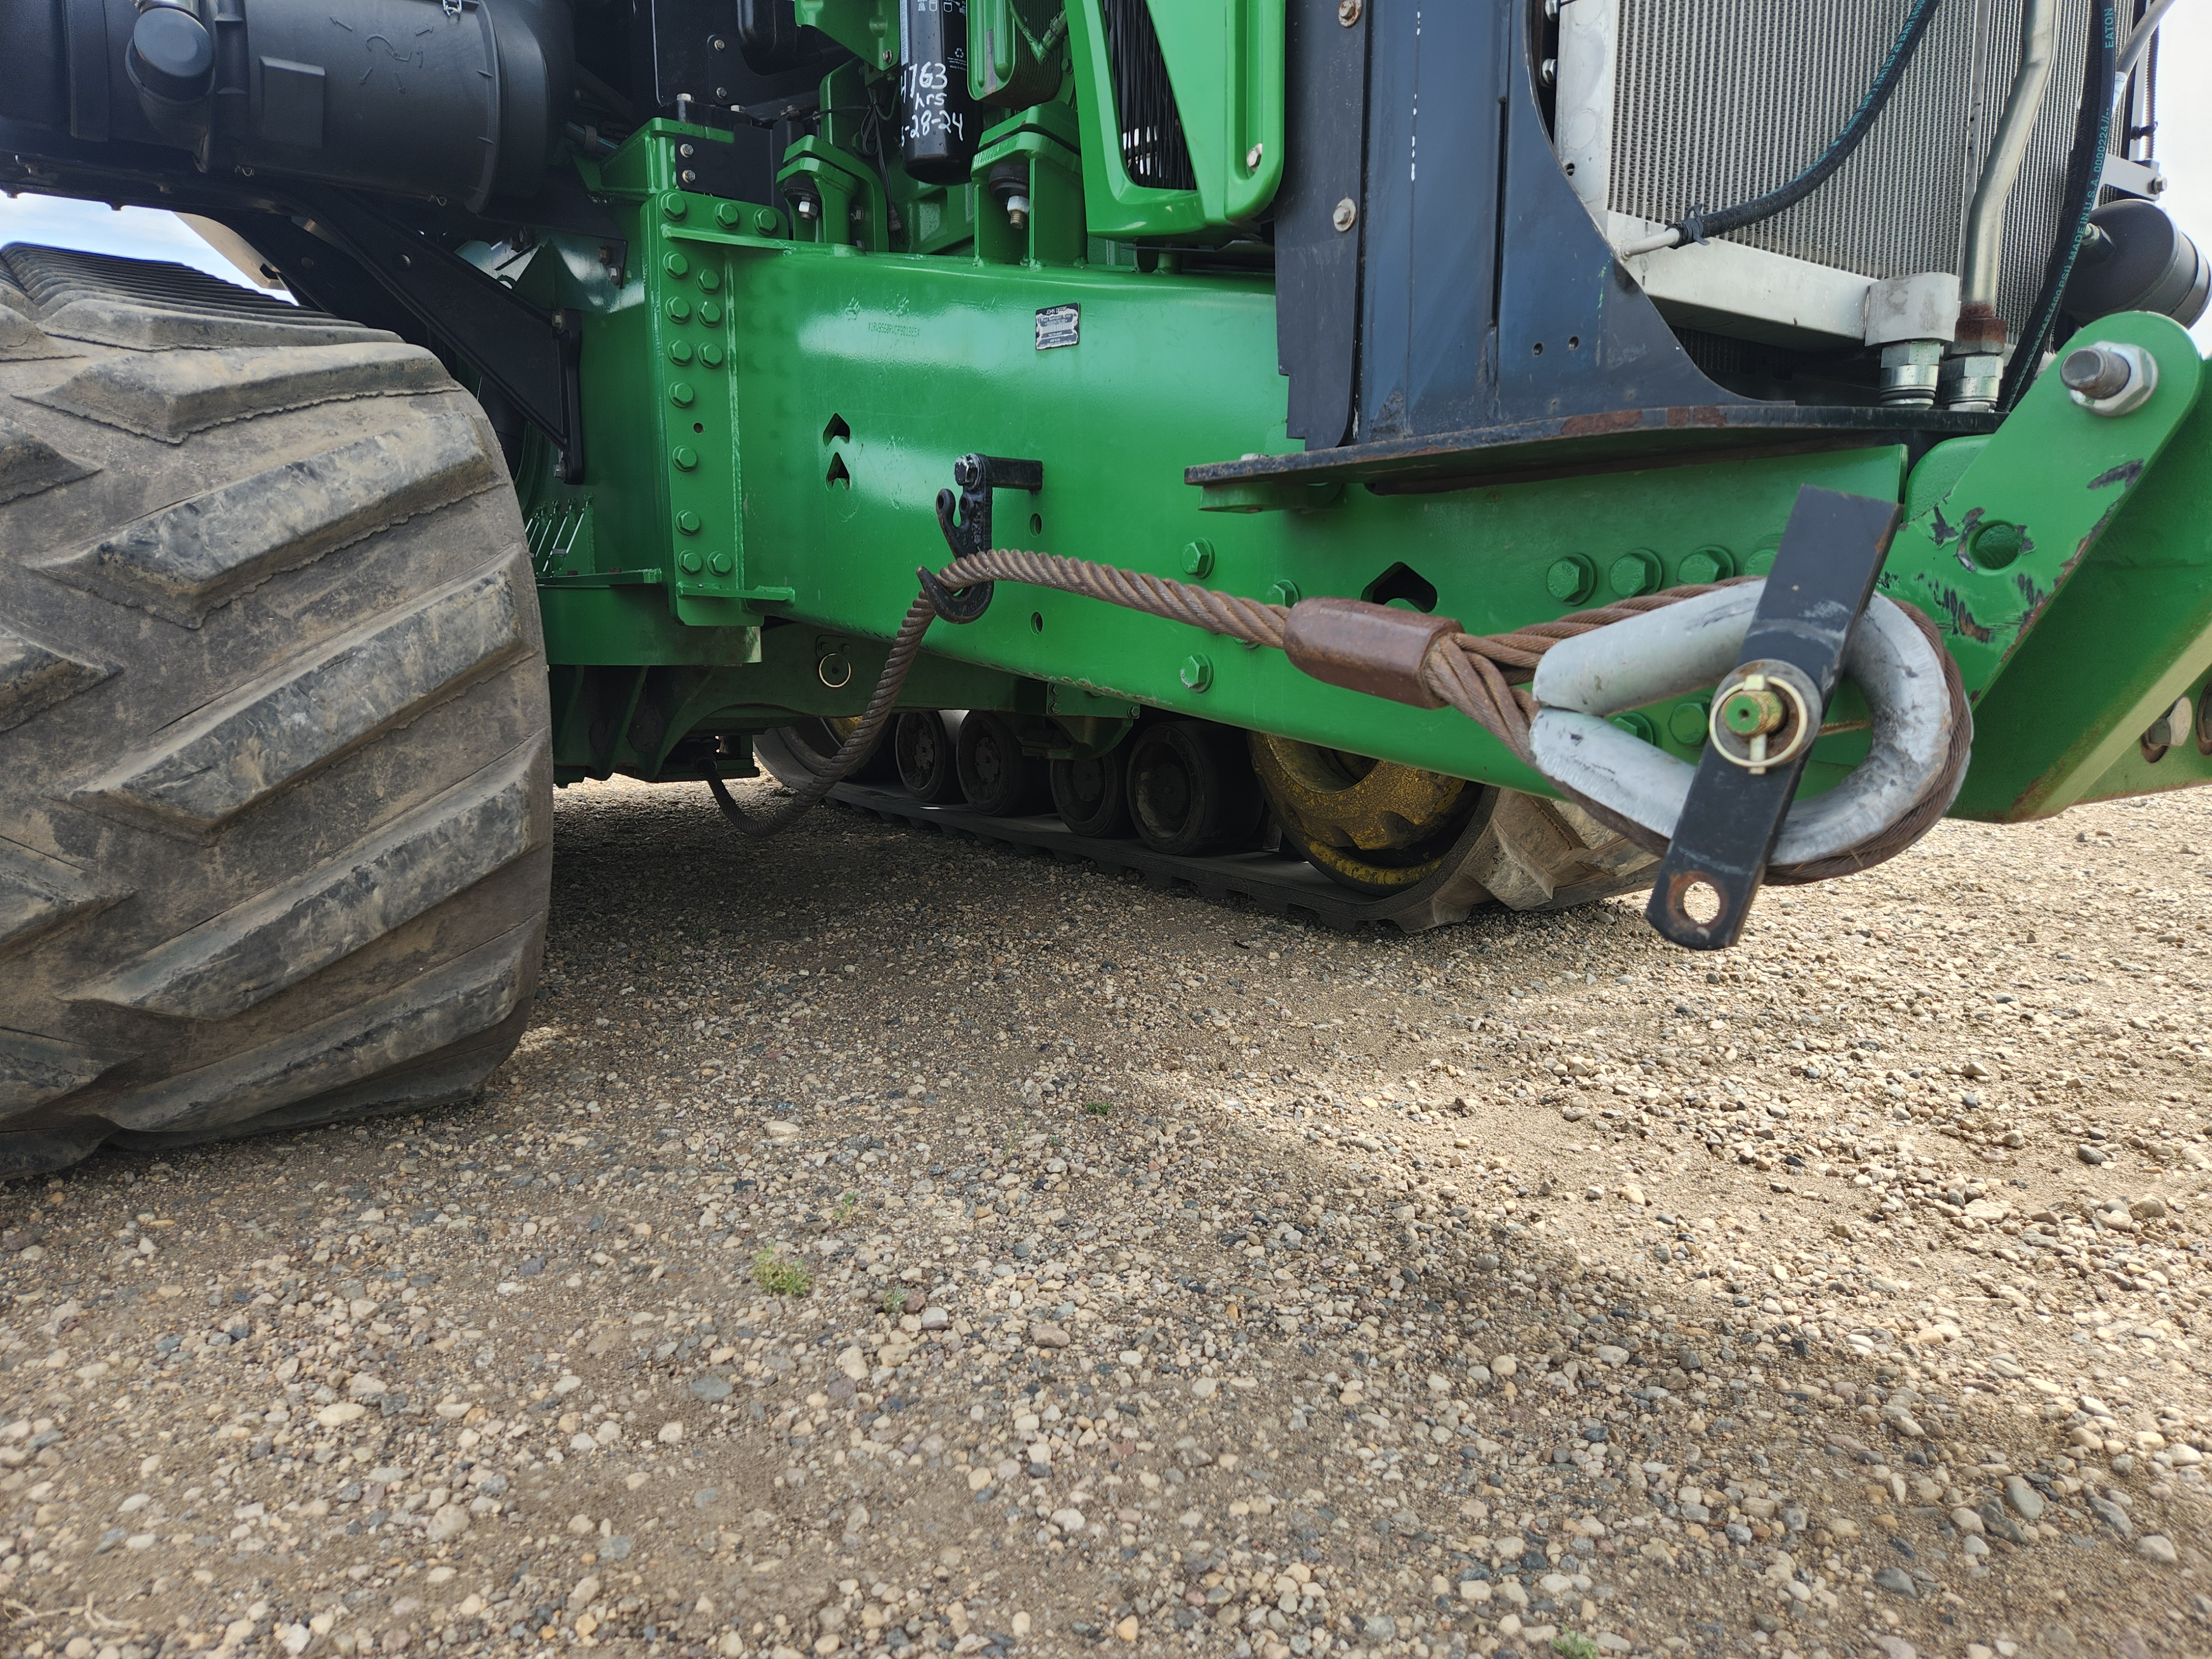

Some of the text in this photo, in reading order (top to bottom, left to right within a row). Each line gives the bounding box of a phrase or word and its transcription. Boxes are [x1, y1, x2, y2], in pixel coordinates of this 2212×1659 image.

[2104, 7, 2114, 49] EATON
[1872, 54, 1895, 86] RATED
[1897, 21, 1913, 43] BAR
[900, 61, 948, 104] 4763
[915, 92, 947, 111] hrs
[2093, 126, 2109, 173] 0000224
[2083, 175, 2100, 210] U.S.A.
[2080, 212, 2089, 225] IN
[2068, 226, 2085, 260] MADE
